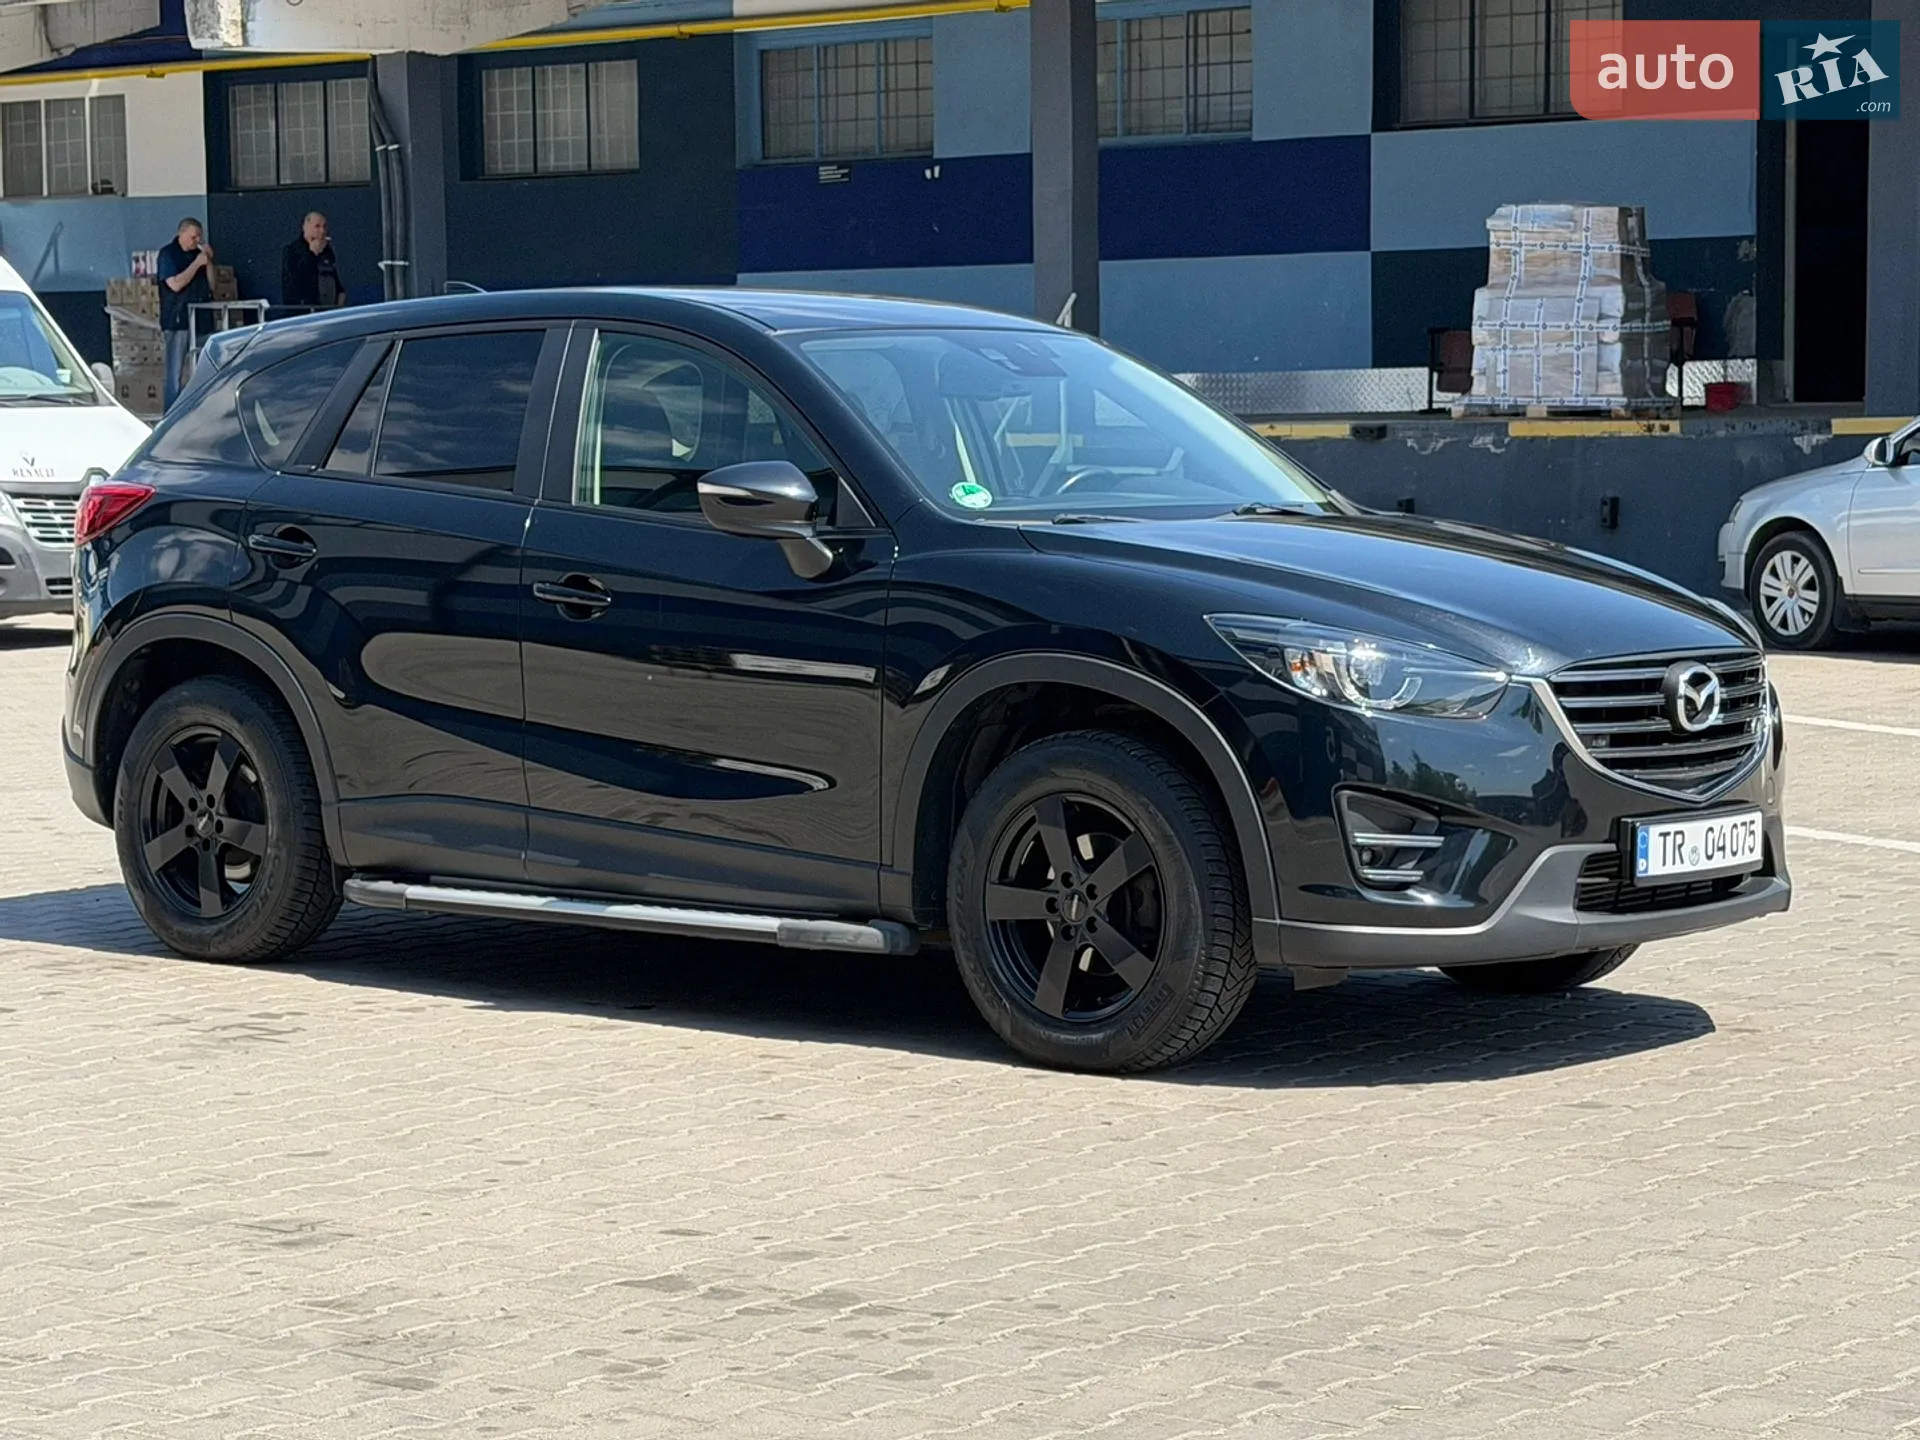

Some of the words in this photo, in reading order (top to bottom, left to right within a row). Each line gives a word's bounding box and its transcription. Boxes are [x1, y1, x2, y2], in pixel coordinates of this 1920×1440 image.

[1658, 830, 1686, 867] TR
[1704, 820, 1756, 861] 04075
[1638, 859, 1647, 871] D
